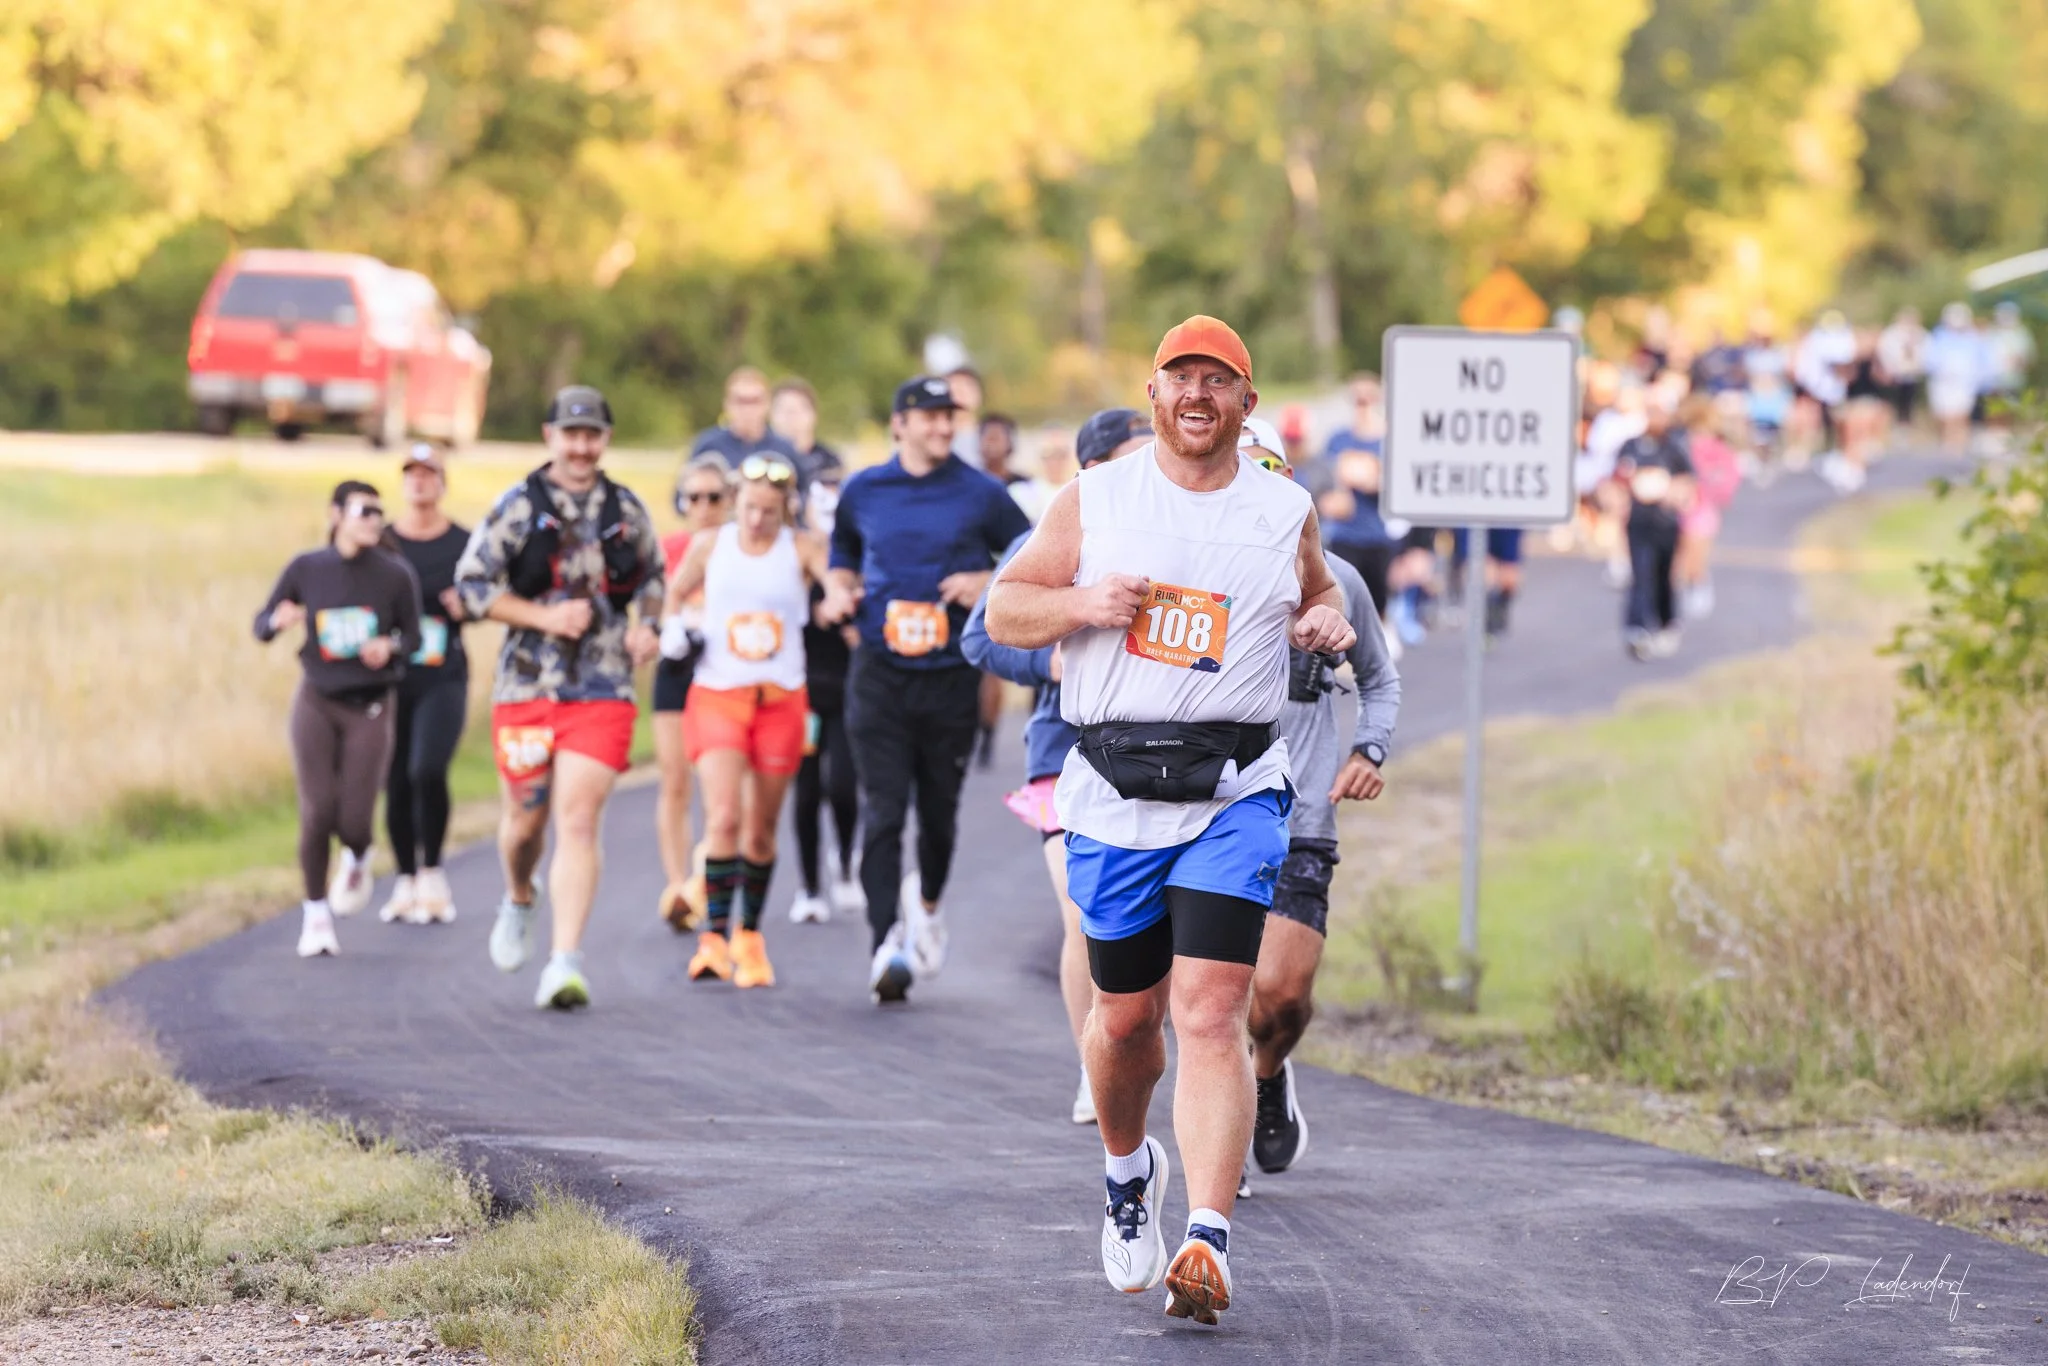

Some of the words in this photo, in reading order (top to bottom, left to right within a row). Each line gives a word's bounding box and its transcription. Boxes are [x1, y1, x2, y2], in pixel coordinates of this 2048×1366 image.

[1459, 356, 1507, 393] NO
[1420, 409, 1541, 446] MOTOR
[1411, 460, 1550, 498] VEHICLES
[1145, 605, 1213, 653] 108
[1146, 647, 1163, 657] HALF
[1164, 651, 1200, 664] MARATHON
[1145, 739, 1184, 747] SALOMON
